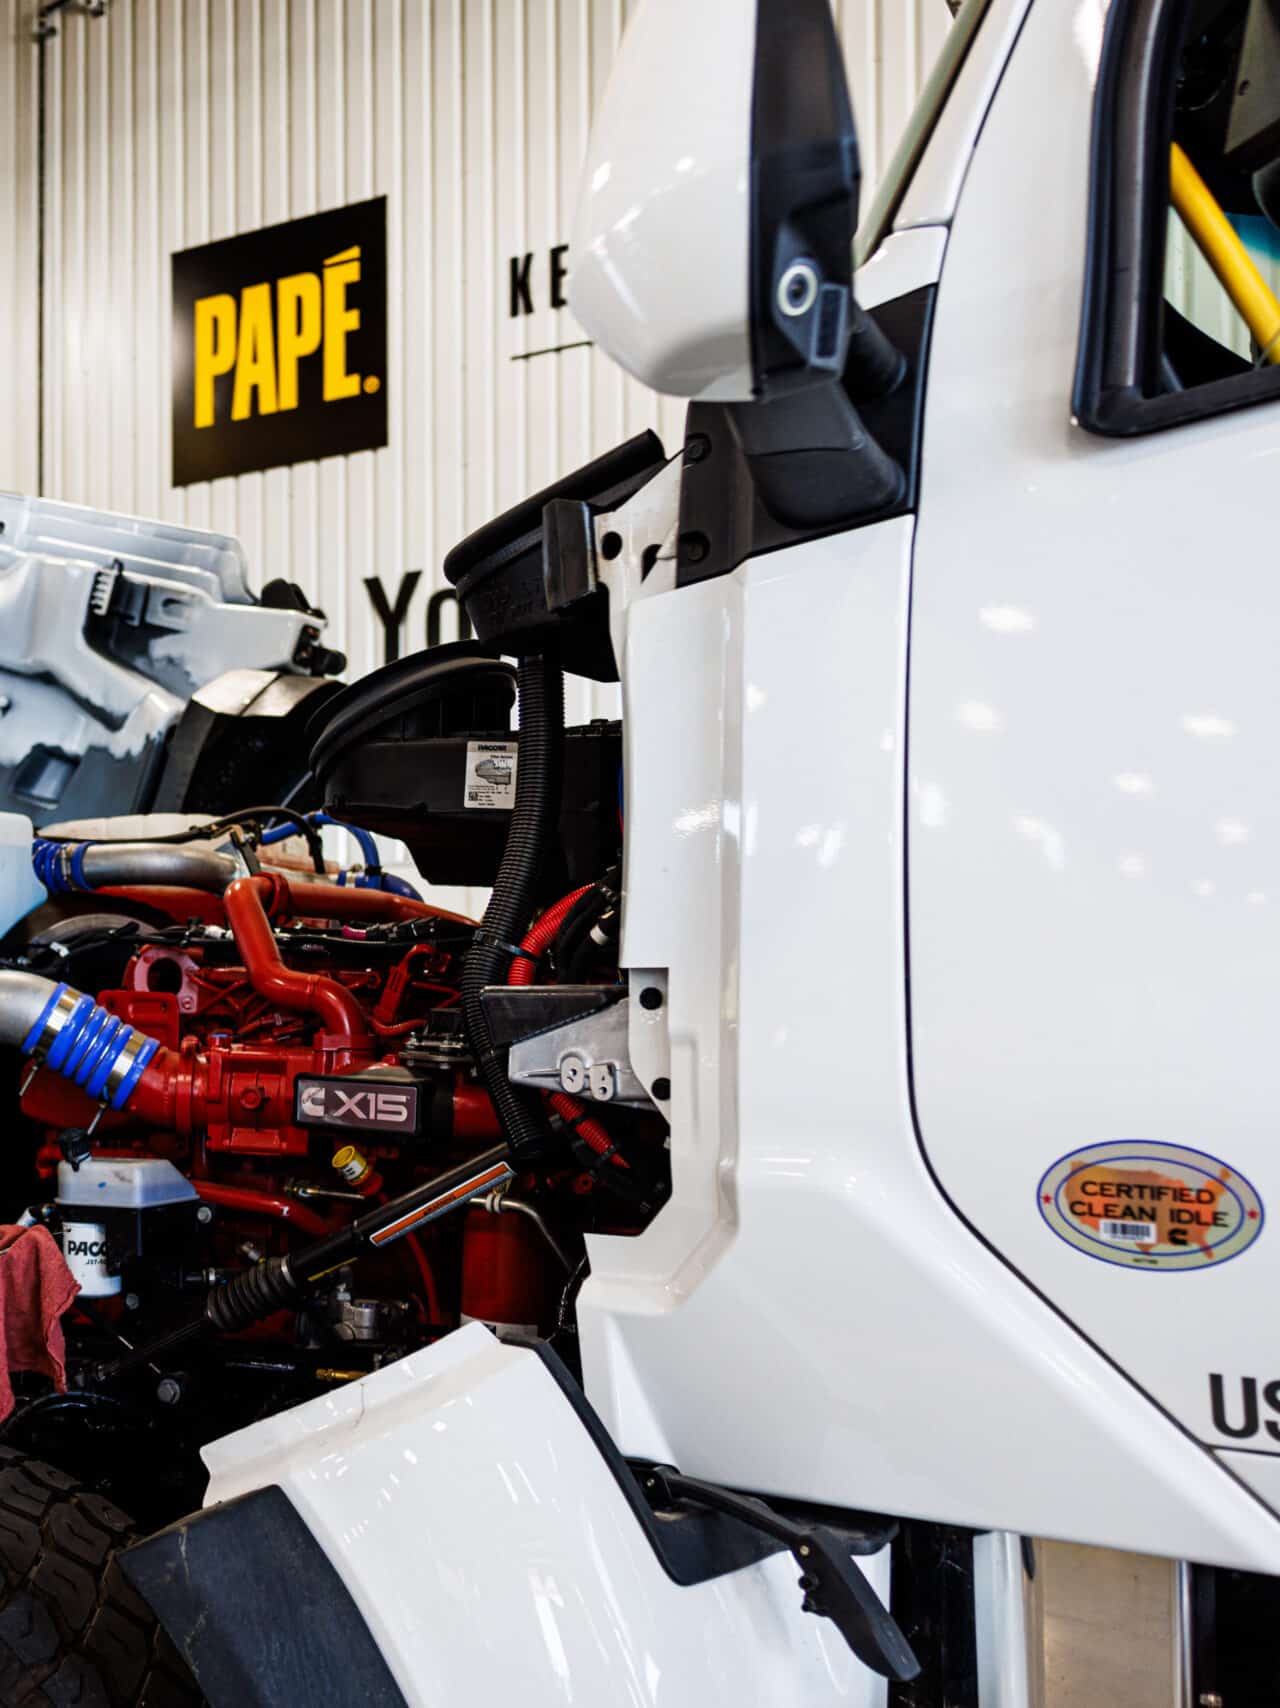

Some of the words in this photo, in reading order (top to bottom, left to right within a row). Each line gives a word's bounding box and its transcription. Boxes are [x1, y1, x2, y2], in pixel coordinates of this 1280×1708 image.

[333, 1089, 409, 1122] X15
[1080, 1180, 1216, 1205] CERTIFIED
[1070, 1200, 1156, 1222] CLEAN
[1169, 1208, 1230, 1228] IDLE
